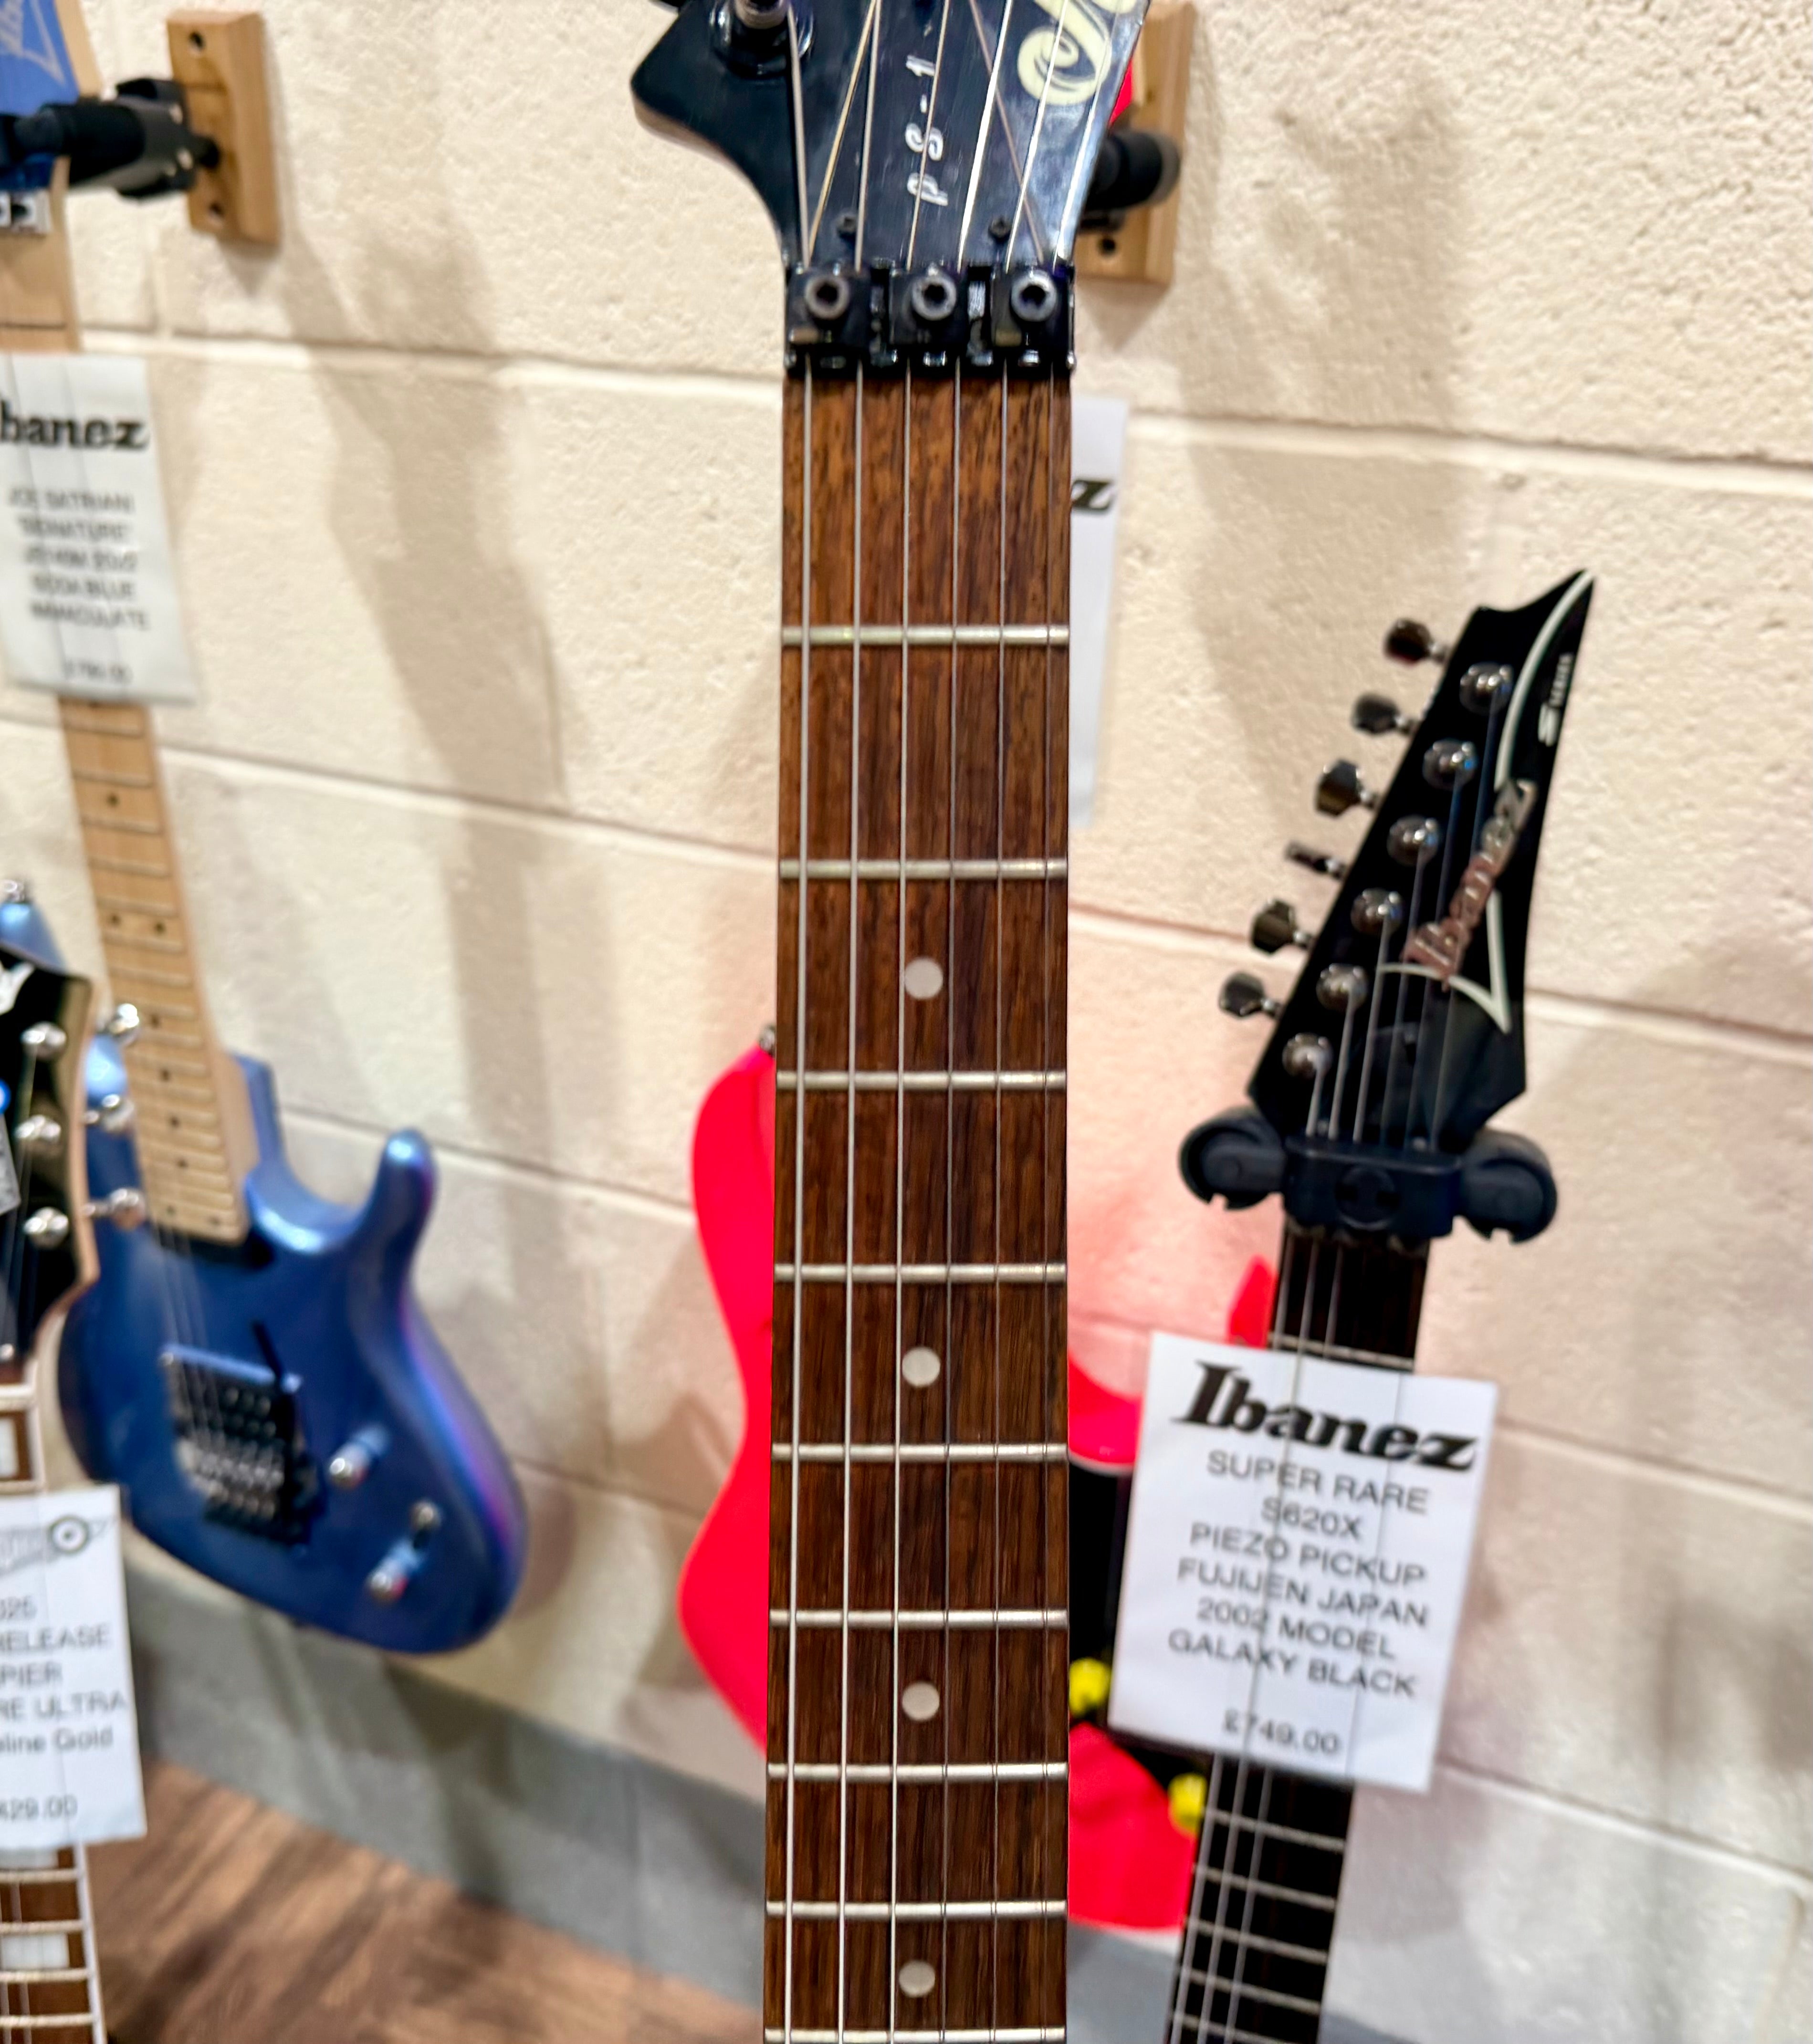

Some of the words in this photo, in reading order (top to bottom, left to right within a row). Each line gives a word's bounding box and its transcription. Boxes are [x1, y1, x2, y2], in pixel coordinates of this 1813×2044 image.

[1170, 1360, 1478, 1473] Ibanez
[1207, 1450, 1322, 1495] SUPER
[1333, 1474, 1430, 1514] RARE
[1261, 1497, 1363, 1541] S620X
[1190, 1522, 1289, 1562] PIEZO
[1298, 1544, 1427, 1586] PICKUP
[1317, 1587, 1428, 1629] JAPAN
[1279, 1615, 1396, 1659] MODEL
[1168, 1628, 1299, 1675] GALAXY
[1307, 1658, 1419, 1698] BLACK
[52, 1726, 113, 1752] Gold
[1222, 1709, 1339, 1753] £749.00
